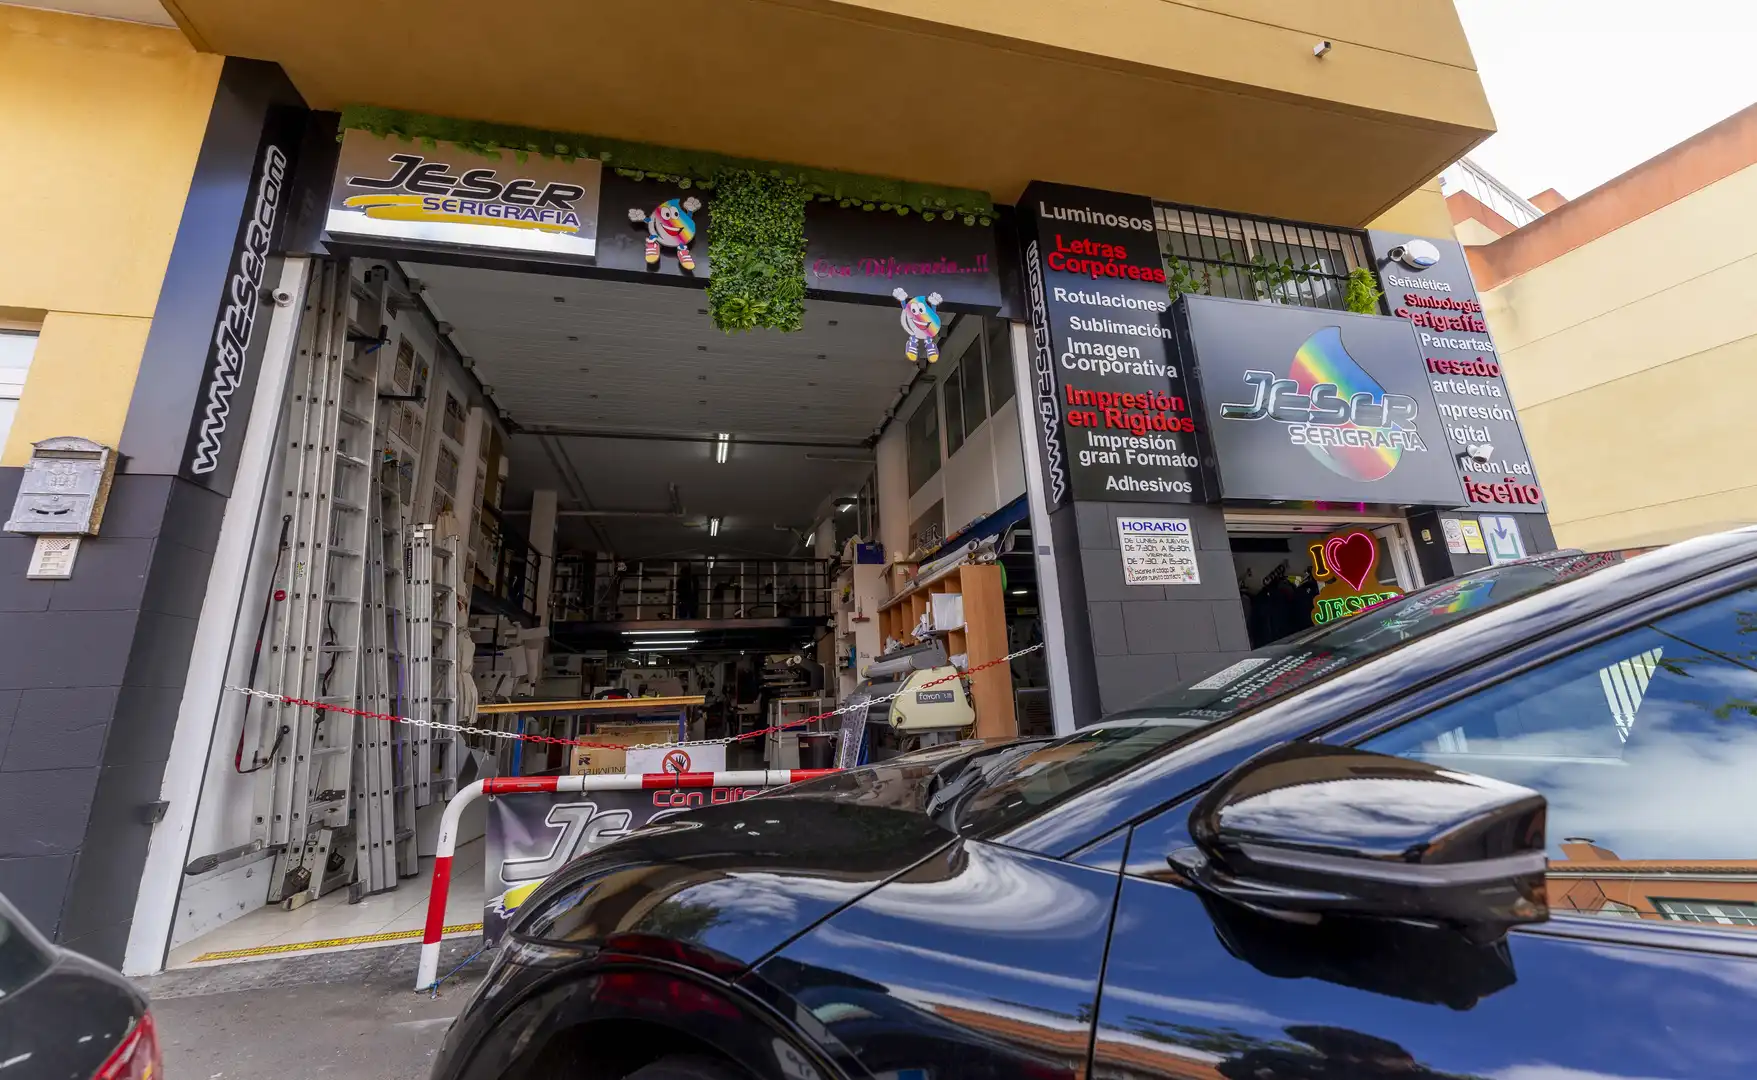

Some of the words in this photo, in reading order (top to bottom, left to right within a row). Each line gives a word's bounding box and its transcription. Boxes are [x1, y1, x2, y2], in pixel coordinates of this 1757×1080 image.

[346, 152, 584, 210] JESER
[422, 196, 580, 228] SERIGRAFIA
[1040, 201, 1154, 232] Luminosos
[1055, 234, 1127, 260] Letras
[1048, 252, 1167, 283] Corpóreas
[1388, 274, 1451, 292] Señalética
[1054, 288, 1166, 312] Rotulaciones
[1069, 316, 1172, 340] Sublimación
[1067, 337, 1140, 361] Imagen
[1420, 332, 1494, 352] Pancartas
[1061, 352, 1178, 378] Corporativa
[1426, 356, 1500, 378] resado
[1065, 384, 1185, 412] Impresión
[1220, 369, 1418, 431] JESER
[1432, 379, 1502, 398] artelería
[1067, 410, 1098, 428] en
[1105, 408, 1196, 436] Rígidos
[1446, 424, 1492, 444] igital
[1088, 431, 1176, 451] Impresión
[1288, 424, 1428, 452] SERIGRAFIA
[1079, 450, 1120, 466] gran
[1126, 449, 1199, 468] Formato
[1461, 458, 1500, 474] Neon
[1502, 460, 1531, 474] Led
[1106, 476, 1192, 492] Adhesivos
[1462, 476, 1542, 504] iseño
[1122, 522, 1186, 532] HORARIO
[1310, 544, 1330, 577] I
[652, 790, 704, 807] Con
[711, 787, 761, 804] Dife
